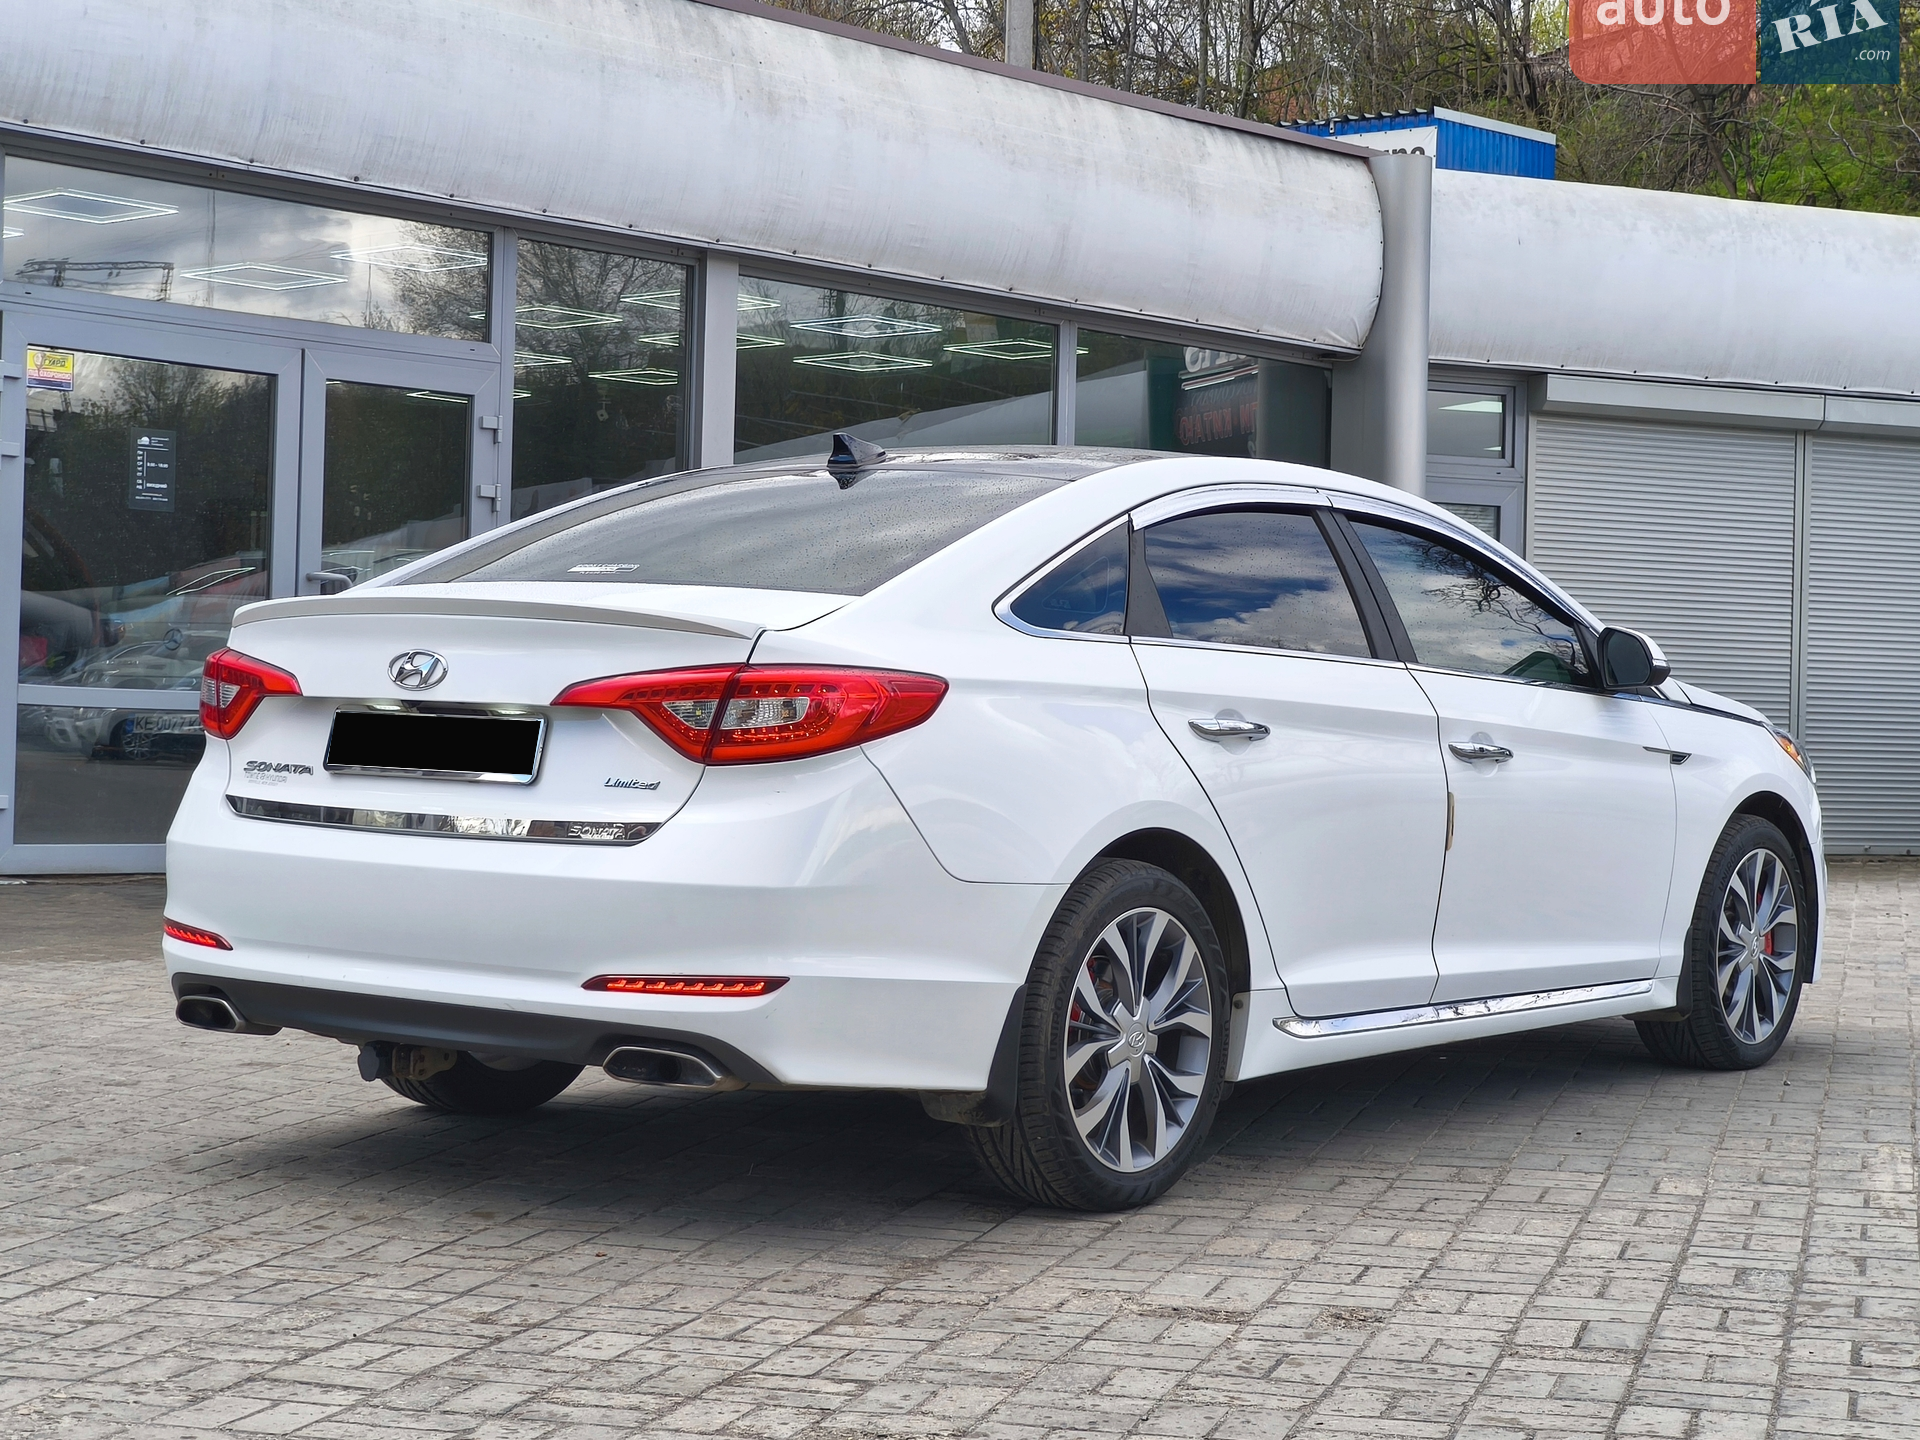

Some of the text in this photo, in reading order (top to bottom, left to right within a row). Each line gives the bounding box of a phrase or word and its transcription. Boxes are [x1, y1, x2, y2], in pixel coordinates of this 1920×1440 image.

[243, 760, 314, 776] SONATA
[603, 777, 661, 791] Limited
[568, 825, 625, 840] SONATA
[1049, 965, 1073, 1061] UNIROYAL
[1211, 1020, 1230, 1108] UNIROYAL
